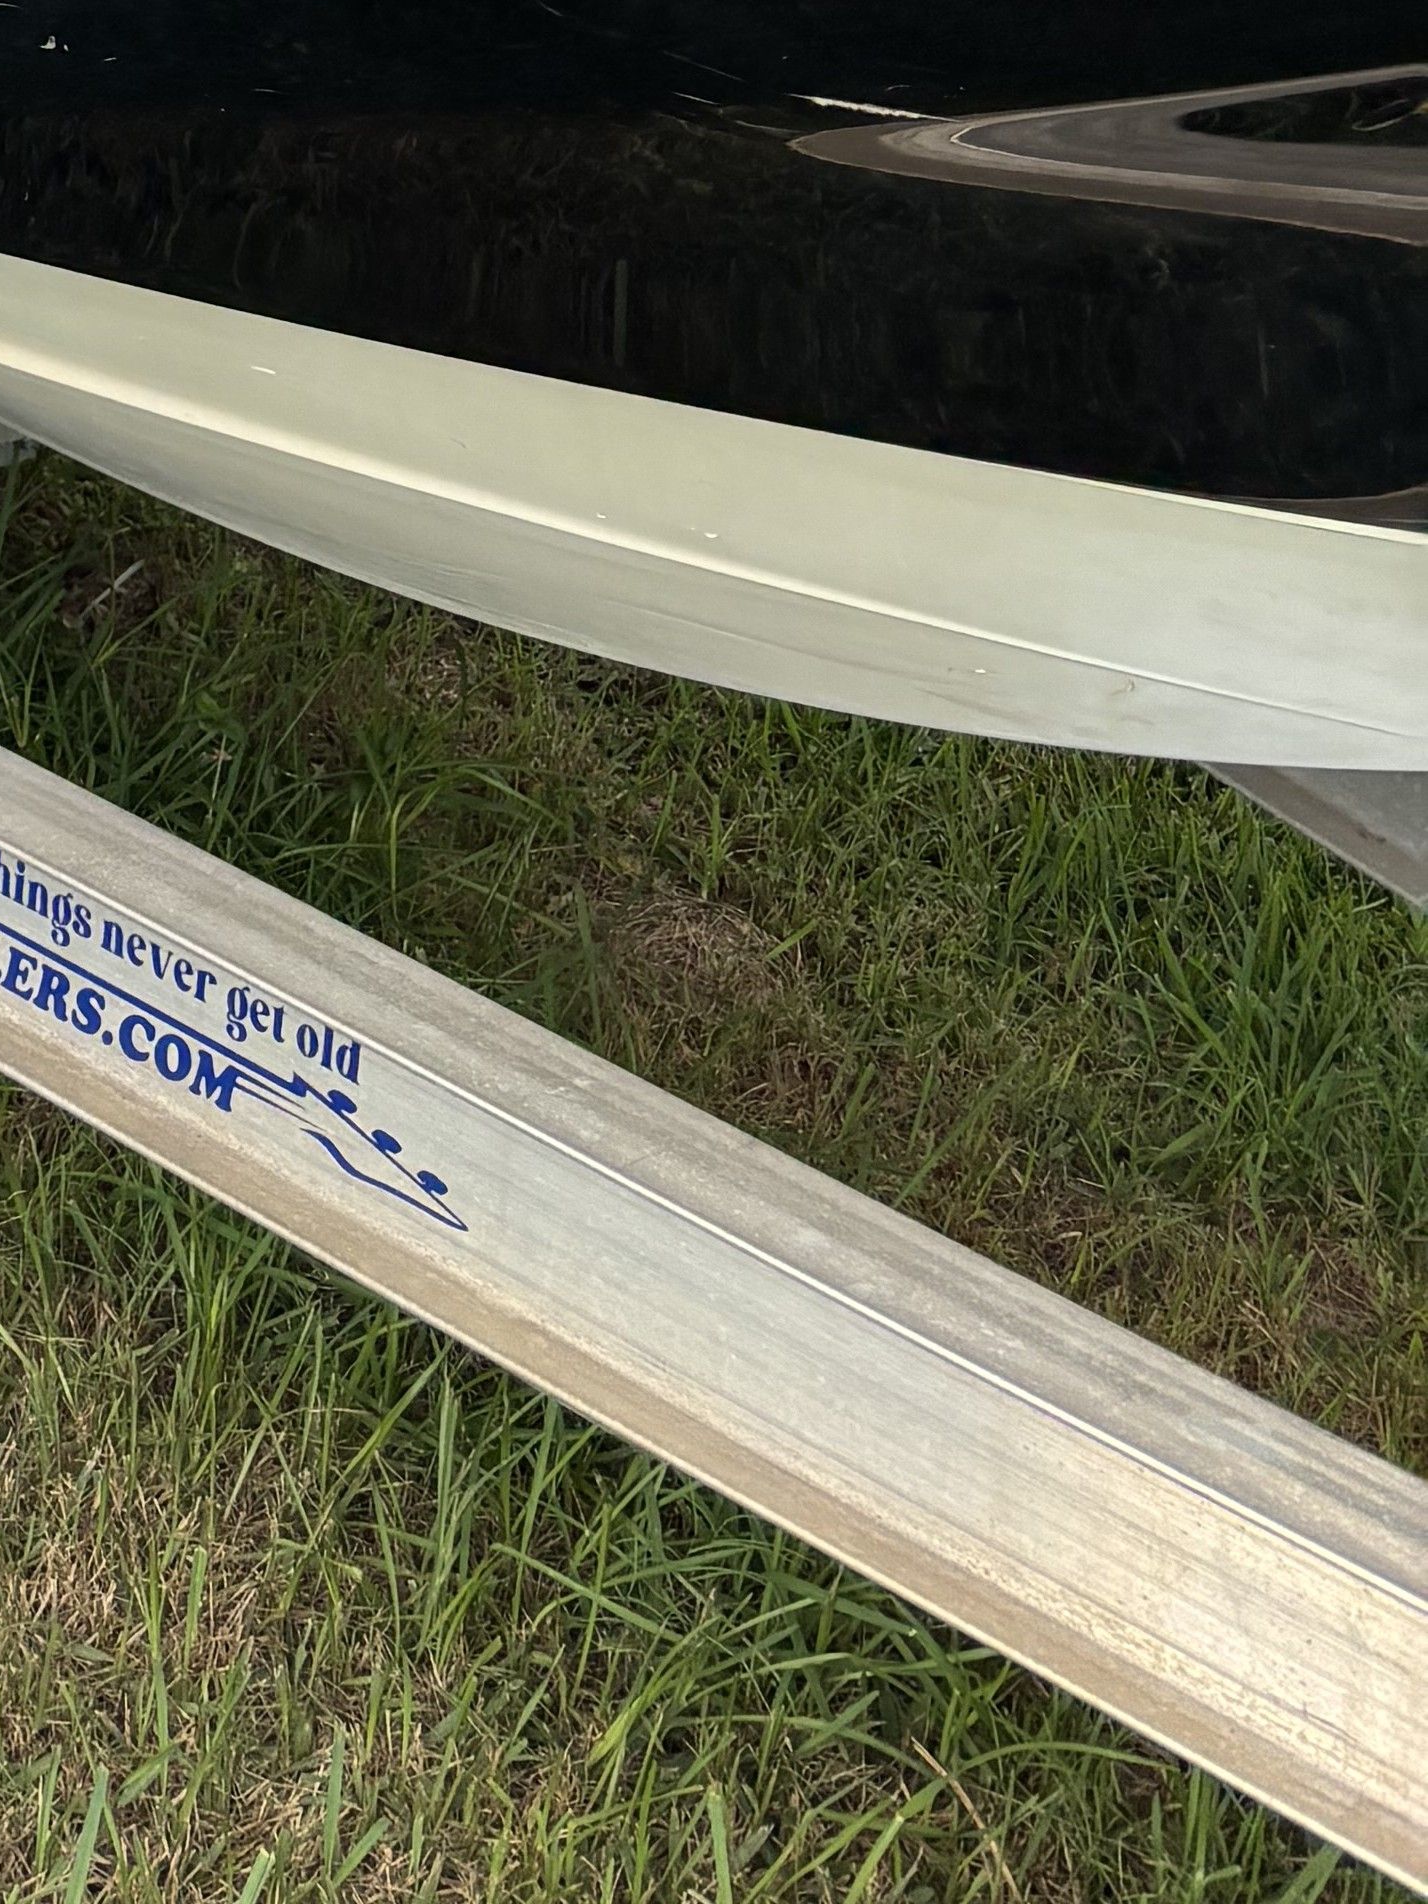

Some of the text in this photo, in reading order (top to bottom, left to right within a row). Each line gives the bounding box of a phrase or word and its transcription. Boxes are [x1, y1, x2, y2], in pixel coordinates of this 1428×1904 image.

[101, 919, 217, 1003] never
[225, 985, 285, 1043] get
[296, 1023, 361, 1085] old
